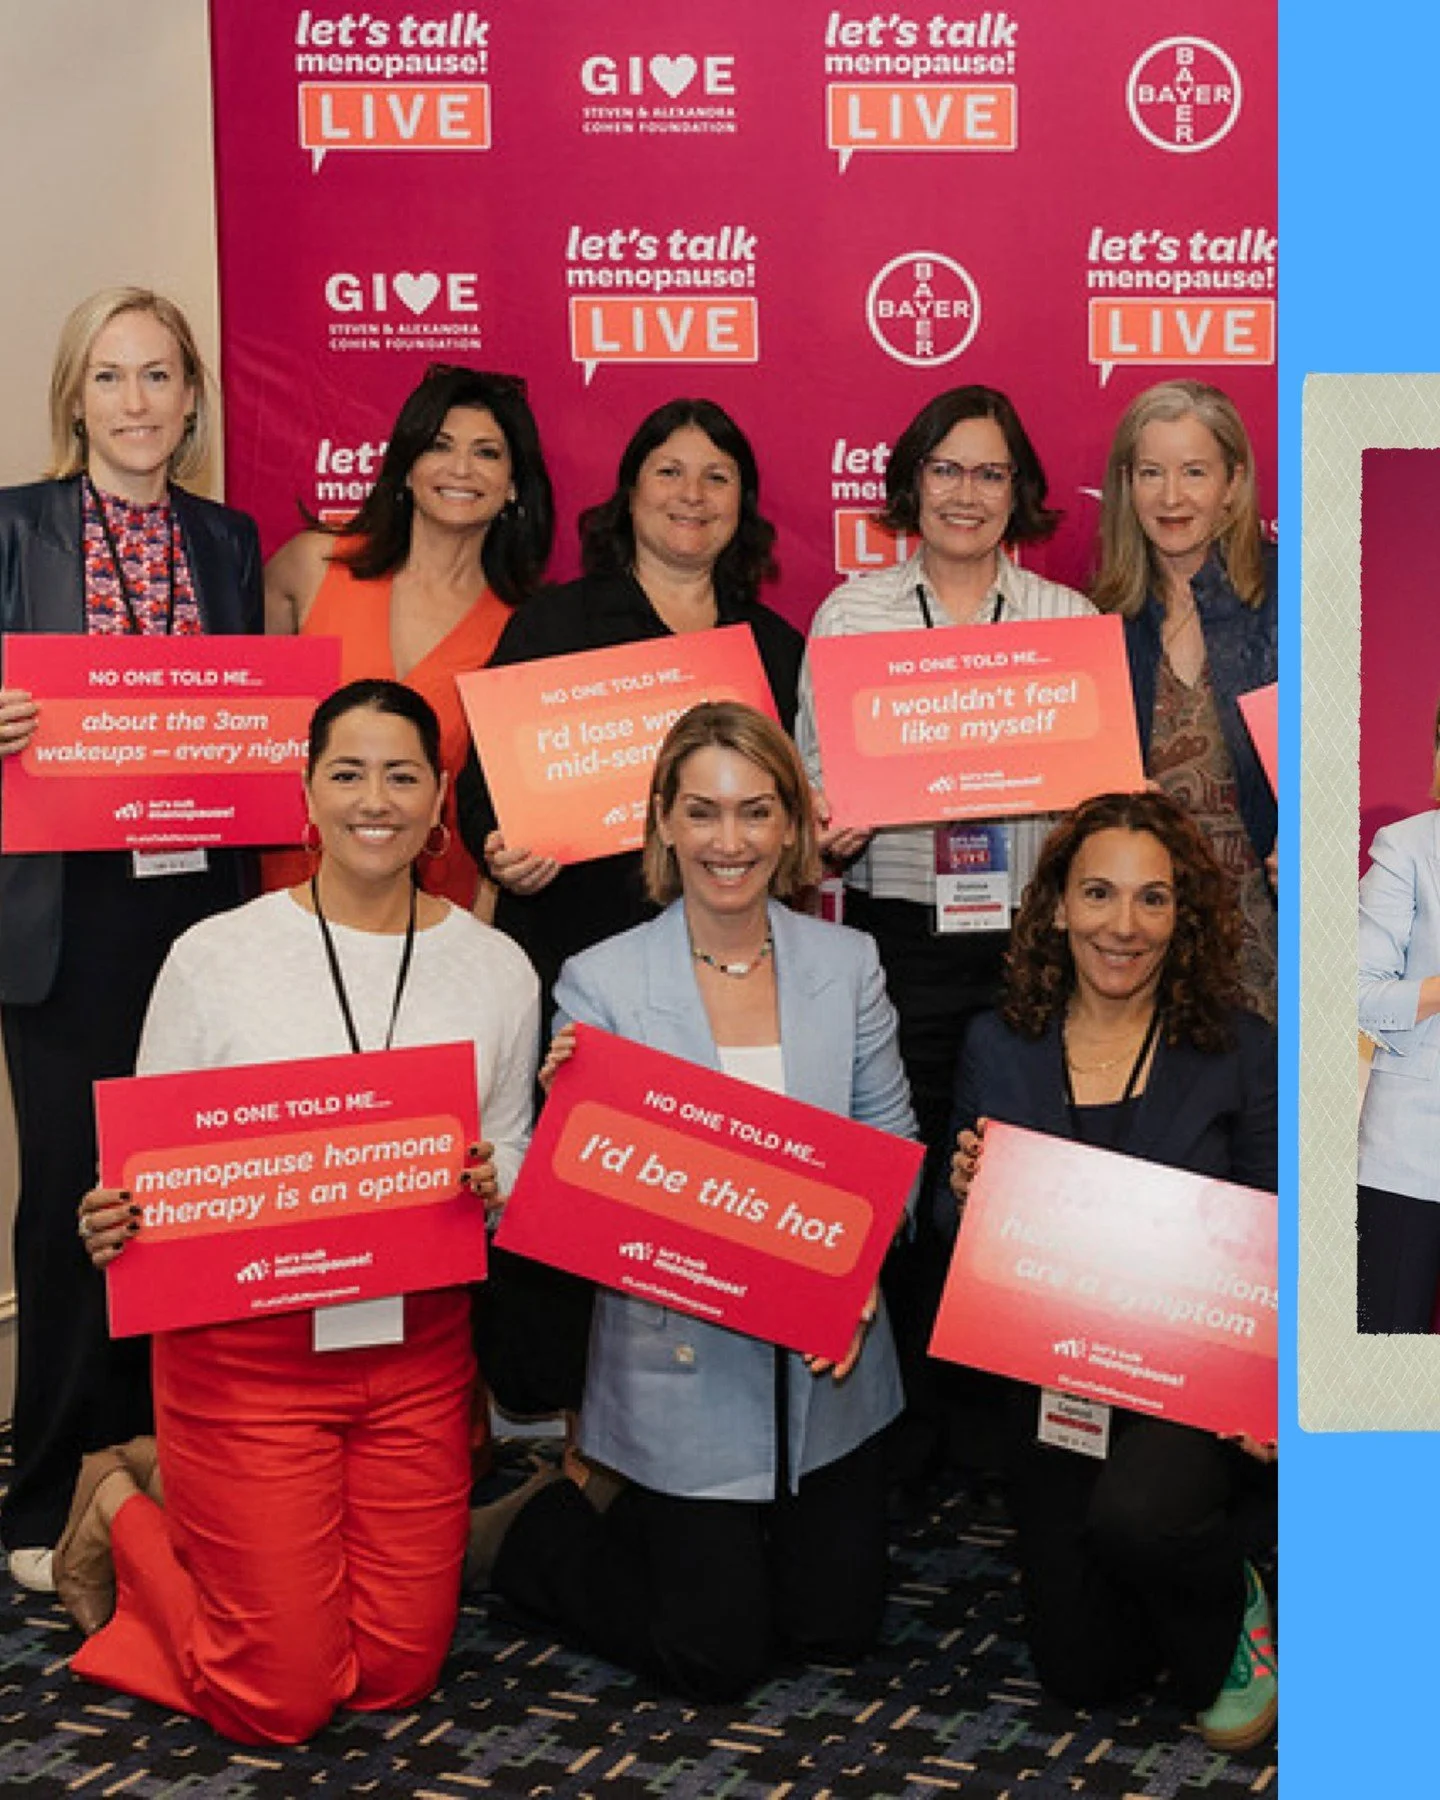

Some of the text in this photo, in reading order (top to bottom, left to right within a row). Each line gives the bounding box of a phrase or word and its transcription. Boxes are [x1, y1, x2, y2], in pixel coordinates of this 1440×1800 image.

[295, 10, 489, 48] let's talk
[824, 11, 1017, 48] let's talk
[295, 51, 489, 79] menopause!
[825, 51, 1016, 79] menopause!
[582, 107, 634, 118] STEVEN
[1138, 85, 1232, 104] BAYER
[320, 93, 472, 140] LIVE
[639, 122, 736, 133] FOUNDATION
[848, 93, 998, 140] LIVE
[565, 226, 758, 262] let's talk
[1087, 227, 1277, 263] let's talk
[567, 263, 757, 292] menopause!
[1087, 266, 1276, 295] menopause!
[878, 300, 970, 318] BAYER
[591, 307, 739, 353] LIVE
[1110, 308, 1256, 354] LIVE
[316, 439, 390, 475] let'
[831, 439, 891, 475] let
[89, 670, 117, 686] NO
[123, 670, 164, 686] ONE
[171, 670, 218, 686] TOLD
[889, 661, 915, 676] NO
[919, 656, 957, 672] ONE
[961, 652, 1008, 670] TOLD
[541, 688, 569, 706] NO
[571, 680, 609, 701] ONE
[612, 673, 654, 694] TOLD
[871, 679, 1078, 718] I wouldn't feel
[82, 709, 269, 732] about the 3am
[579, 717, 635, 746] lose
[901, 708, 1057, 745] like myself
[36, 742, 147, 767] wakeups
[175, 742, 242, 765] every
[546, 739, 665, 781] mid-sen
[196, 1110, 229, 1130] NO
[234, 1102, 281, 1124] ONE
[286, 1096, 341, 1118] TOLD
[643, 1089, 677, 1115] NO
[680, 1102, 726, 1133] ONE
[729, 1118, 780, 1151] TOLD
[135, 1132, 455, 1194] menopause hormone
[142, 1167, 452, 1228] therapy is an option
[579, 1134, 846, 1249] I'd be this hot
